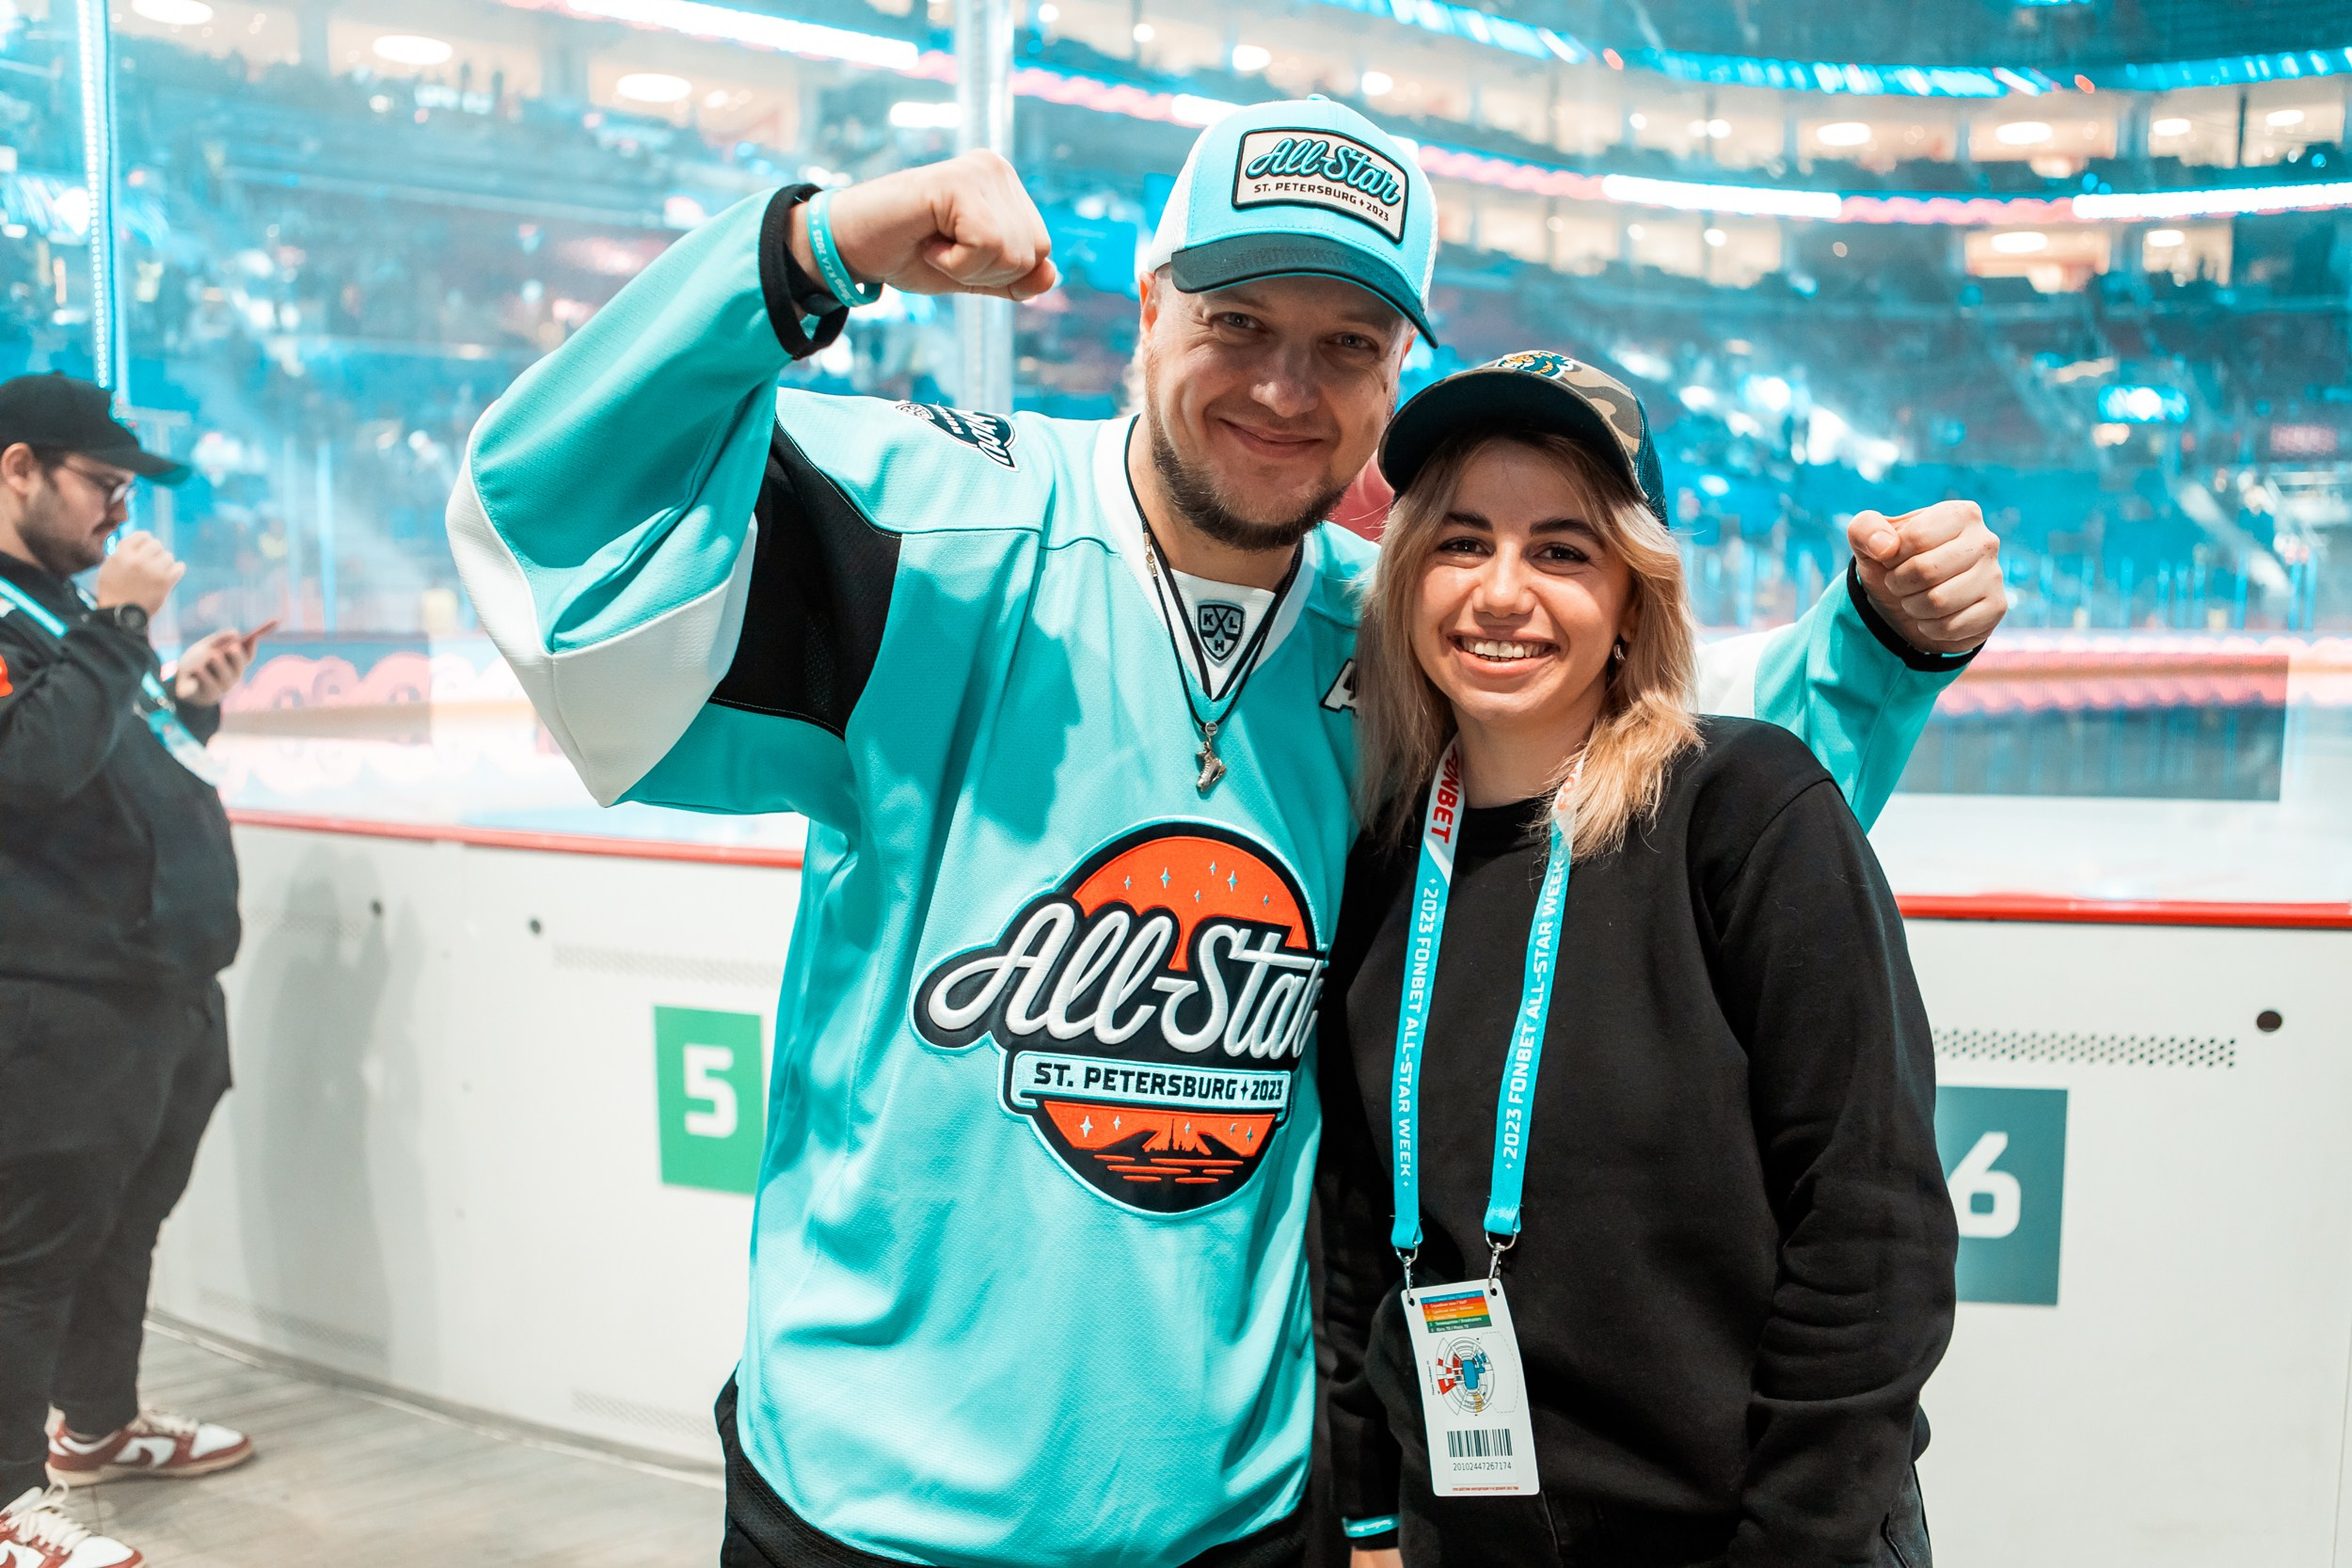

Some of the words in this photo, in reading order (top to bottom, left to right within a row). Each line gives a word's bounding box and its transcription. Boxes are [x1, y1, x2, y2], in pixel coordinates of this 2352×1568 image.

[1247, 138, 1402, 205] All-Star
[1254, 183, 1271, 193] ST.
[1276, 182, 1357, 204] PETERSBURG
[1366, 202, 1390, 222] 2023
[1431, 744, 1460, 844] FONBET
[1418, 887, 1438, 934] 2023
[1542, 858, 1565, 918] WEEK
[928, 902, 1324, 1059] All-Star
[1408, 937, 1431, 1014] FONBET
[1526, 922, 1552, 1020] ALL-STAR
[683, 1042, 739, 1139] 5
[1035, 1063, 1073, 1087] ST.
[1084, 1066, 1238, 1101] PETERSBURG
[1249, 1079, 1283, 1101] 2023
[1398, 1017, 1420, 1113] ALL-STAR
[1508, 1023, 1536, 1104] FONBET
[1398, 1118, 1411, 1177] WEEK
[1503, 1108, 1522, 1160] 2023
[1947, 1131, 2022, 1239] 6
[1453, 1462, 1512, 1471] 20102447267174
